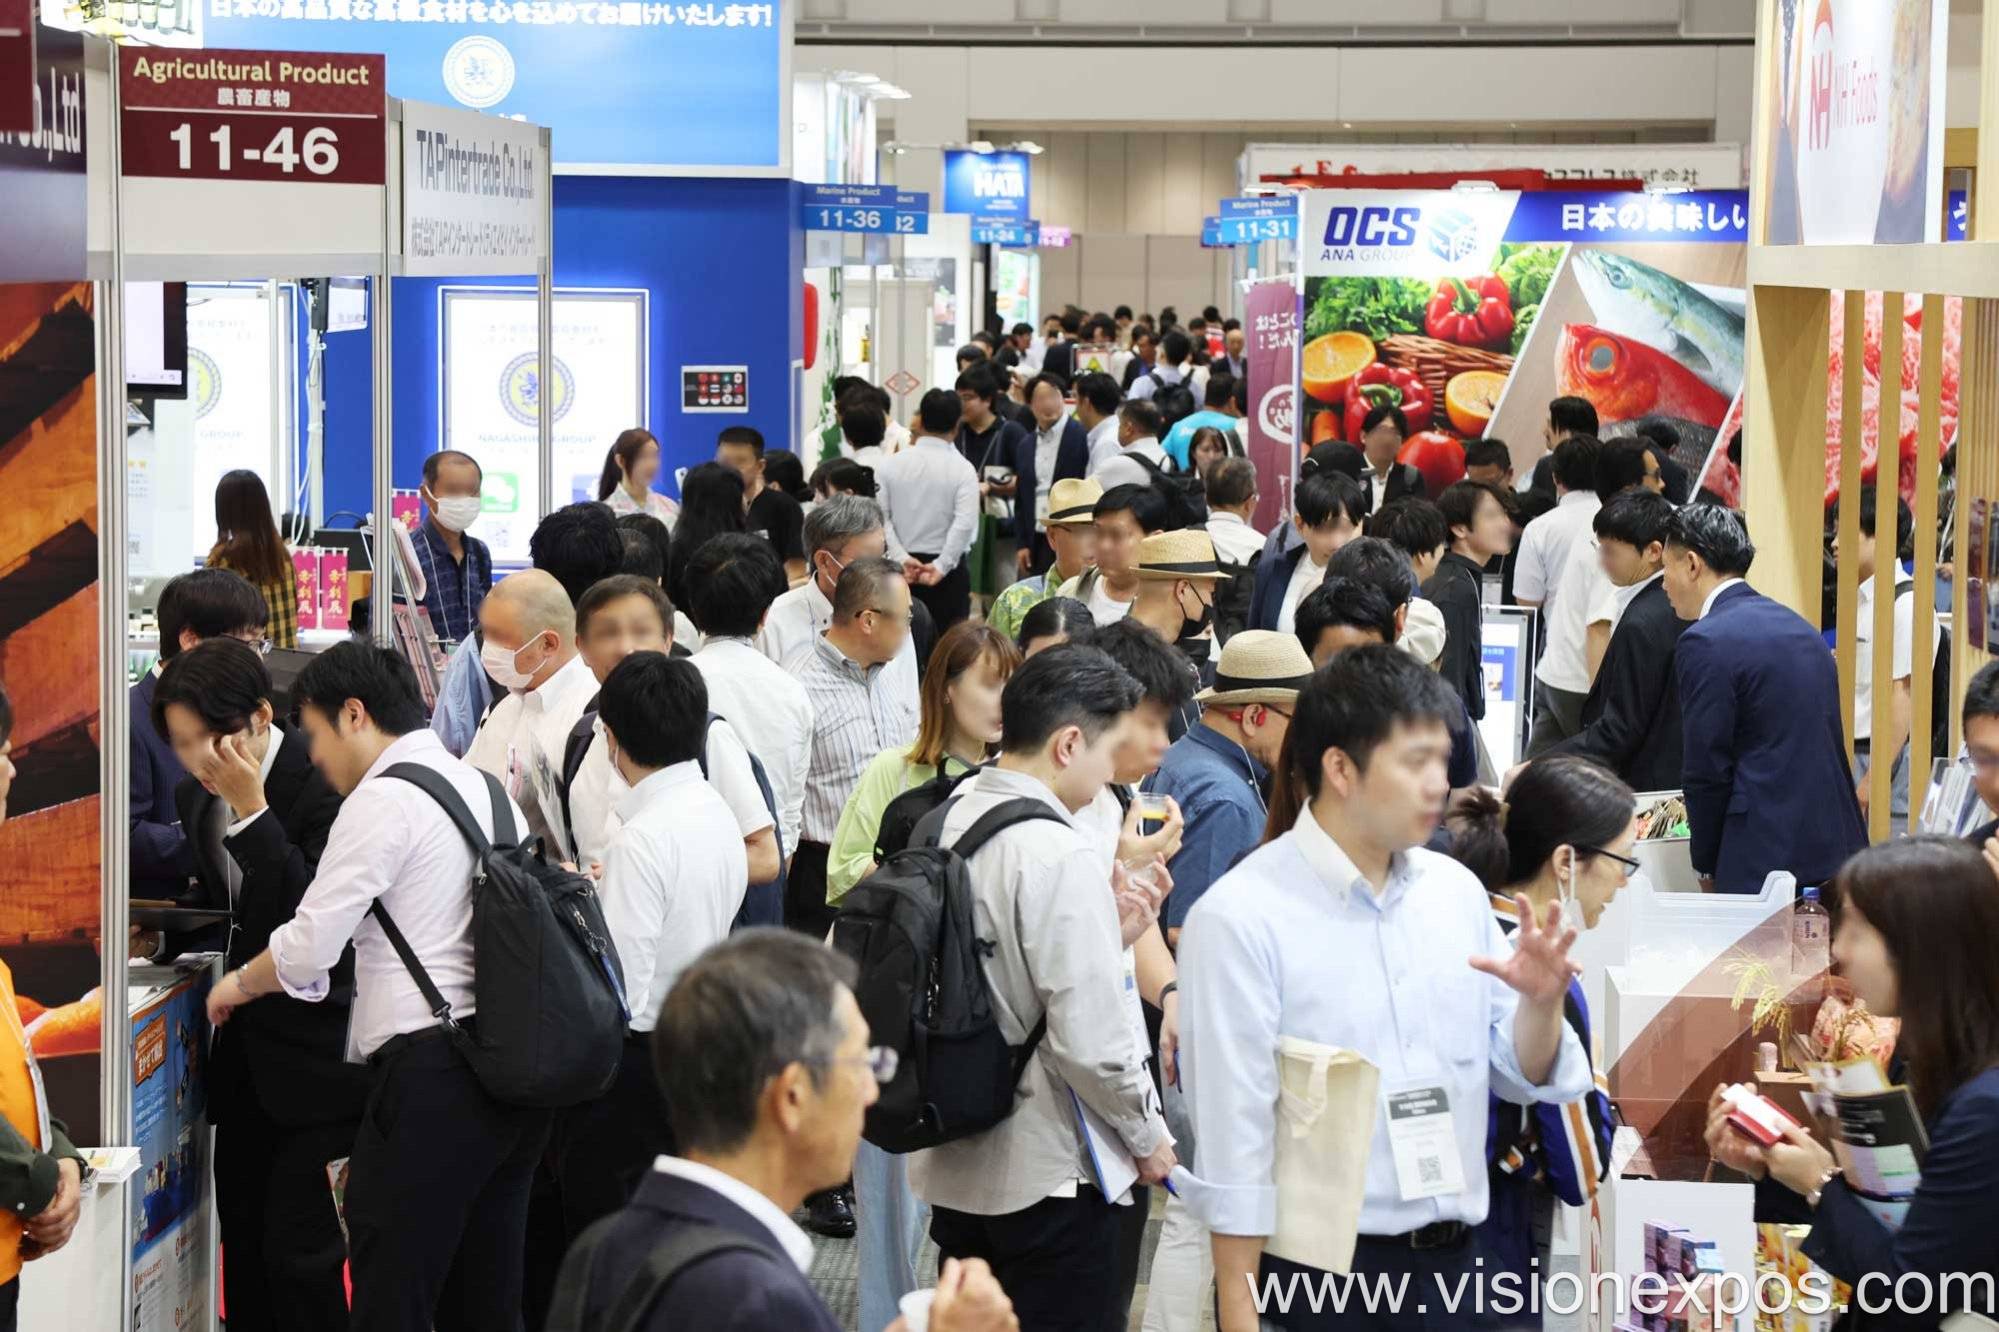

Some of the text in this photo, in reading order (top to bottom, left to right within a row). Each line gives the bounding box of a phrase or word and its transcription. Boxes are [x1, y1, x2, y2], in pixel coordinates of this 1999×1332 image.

[134, 56, 369, 85] Agricultural Product
[170, 123, 339, 175] 11-46
[815, 186, 881, 196] Marine Product
[820, 209, 881, 228] 11-36
[1323, 206, 1421, 247] OCS
[1236, 219, 1290, 239] 11-31
[1320, 249, 1355, 262] ANA
